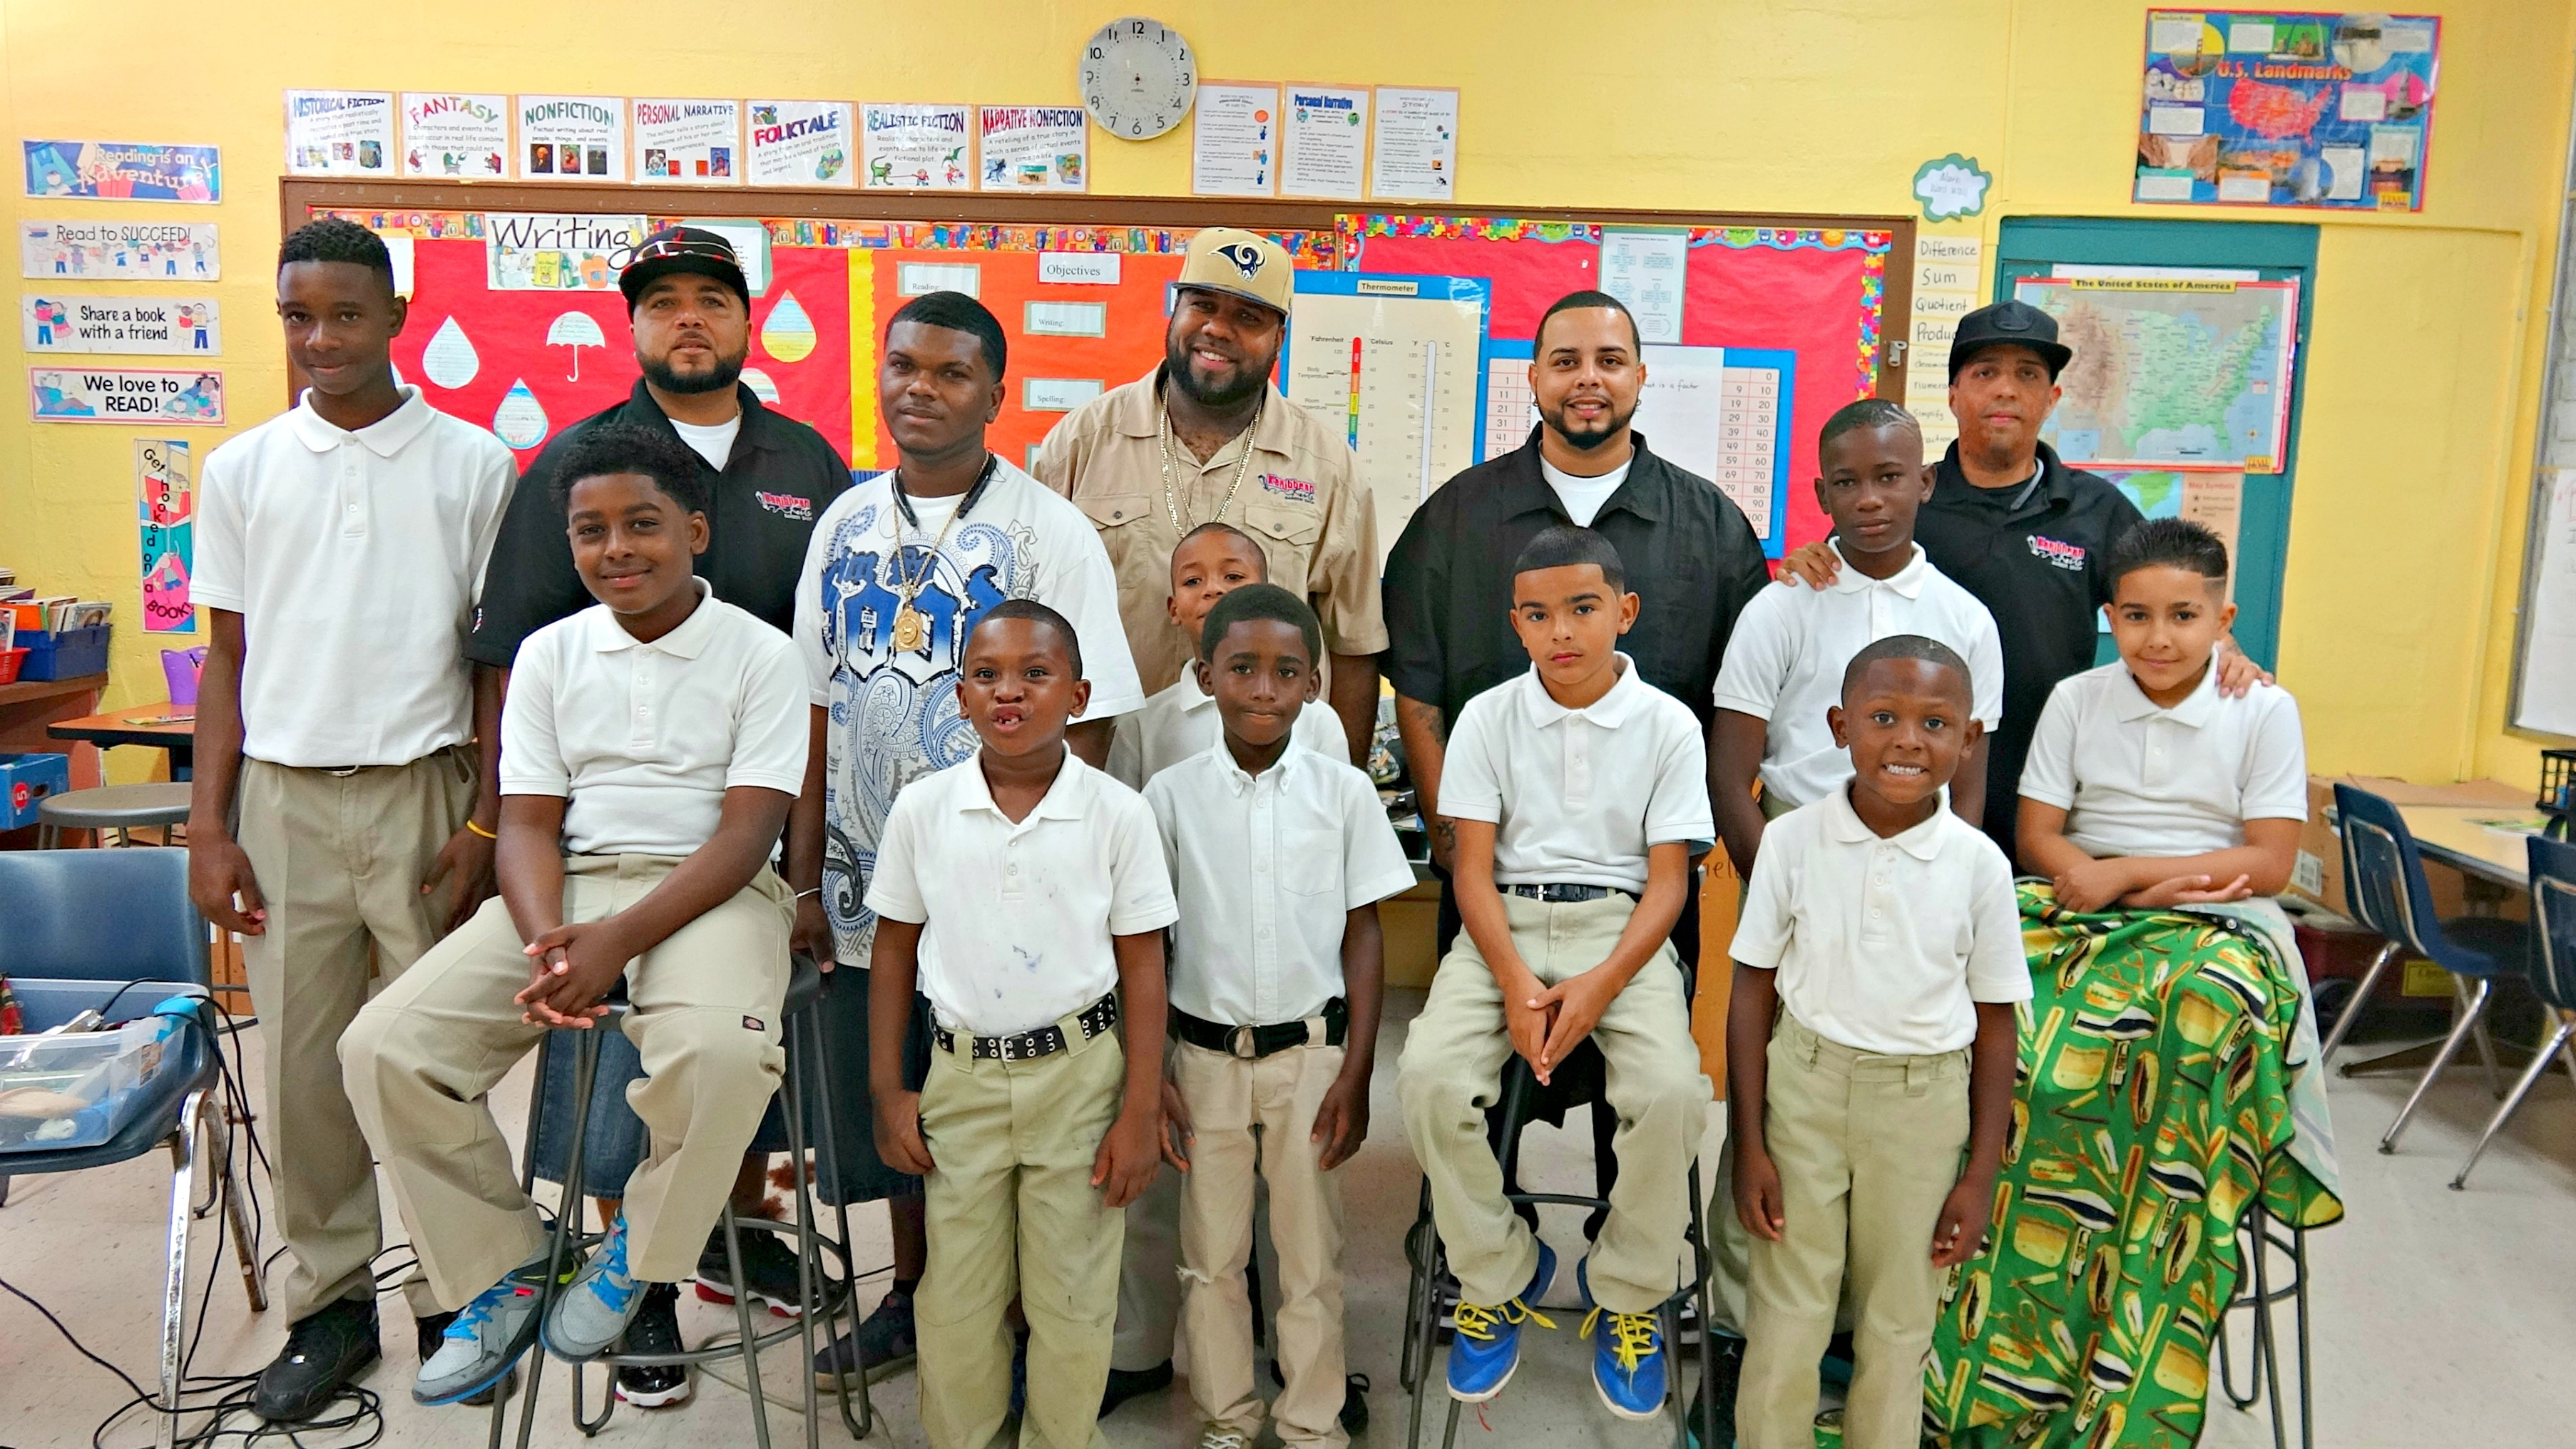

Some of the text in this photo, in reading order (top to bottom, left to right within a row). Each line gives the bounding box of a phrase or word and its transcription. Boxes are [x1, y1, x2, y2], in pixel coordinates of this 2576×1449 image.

[1108, 29, 1117, 40] 11
[1133, 22, 1144, 34] 12
[1162, 30, 1165, 42] 1
[1090, 47, 1102, 59] 10
[1180, 48, 1185, 60] 2
[2217, 61, 2352, 80] U.S. Landmarks
[1086, 71, 1094, 84] 9
[1182, 73, 1190, 86] 3
[294, 97, 384, 118] HISTORICAL FICTION
[1091, 96, 1100, 110] 8
[1172, 96, 1182, 110] 4
[1294, 94, 1322, 108] Personal
[409, 96, 499, 124] FANTASY
[525, 102, 615, 128] NONFICTION
[637, 104, 735, 126] PERSONAL NARRATIVE
[867, 109, 964, 133] REALISTIC FICTION
[983, 108, 1083, 138] NARRATIVE NONFICTION
[1110, 116, 1117, 128] 7
[1157, 116, 1165, 128] 5
[753, 111, 839, 148] FOLKTALE
[1133, 121, 1141, 135] 6
[994, 135, 1021, 144] retelling
[96, 148, 155, 165] Reading
[175, 153, 194, 165] an
[56, 225, 191, 242] Read to SUCCEED!
[491, 217, 634, 270] Writing
[1921, 240, 1978, 257] Difference
[1046, 264, 1101, 277] Objectives
[1922, 268, 1957, 286] Sum
[1361, 283, 1415, 293] Thermometer
[1916, 297, 1967, 312] Quotient
[80, 304, 166, 322] Share a book
[1038, 318, 1064, 327] Writing:
[79, 324, 168, 340] with a friend
[1917, 322, 1956, 342] Produc
[83, 375, 179, 393] We love to
[1677, 379, 1700, 392] factor
[105, 396, 159, 413] READ!
[1037, 395, 1066, 404] Spelling:
[1731, 400, 1742, 409] 19
[1729, 414, 1740, 423] 29
[1913, 409, 1944, 421] Simplify
[1923, 435, 1952, 444] action
[1726, 456, 1737, 465] 59
[1725, 471, 1737, 479] 69
[1753, 500, 1764, 508] 90
[1748, 513, 1763, 522] 100
[143, 449, 194, 619] Get hooked on a BOOK!
[16, 790, 28, 801] 5
